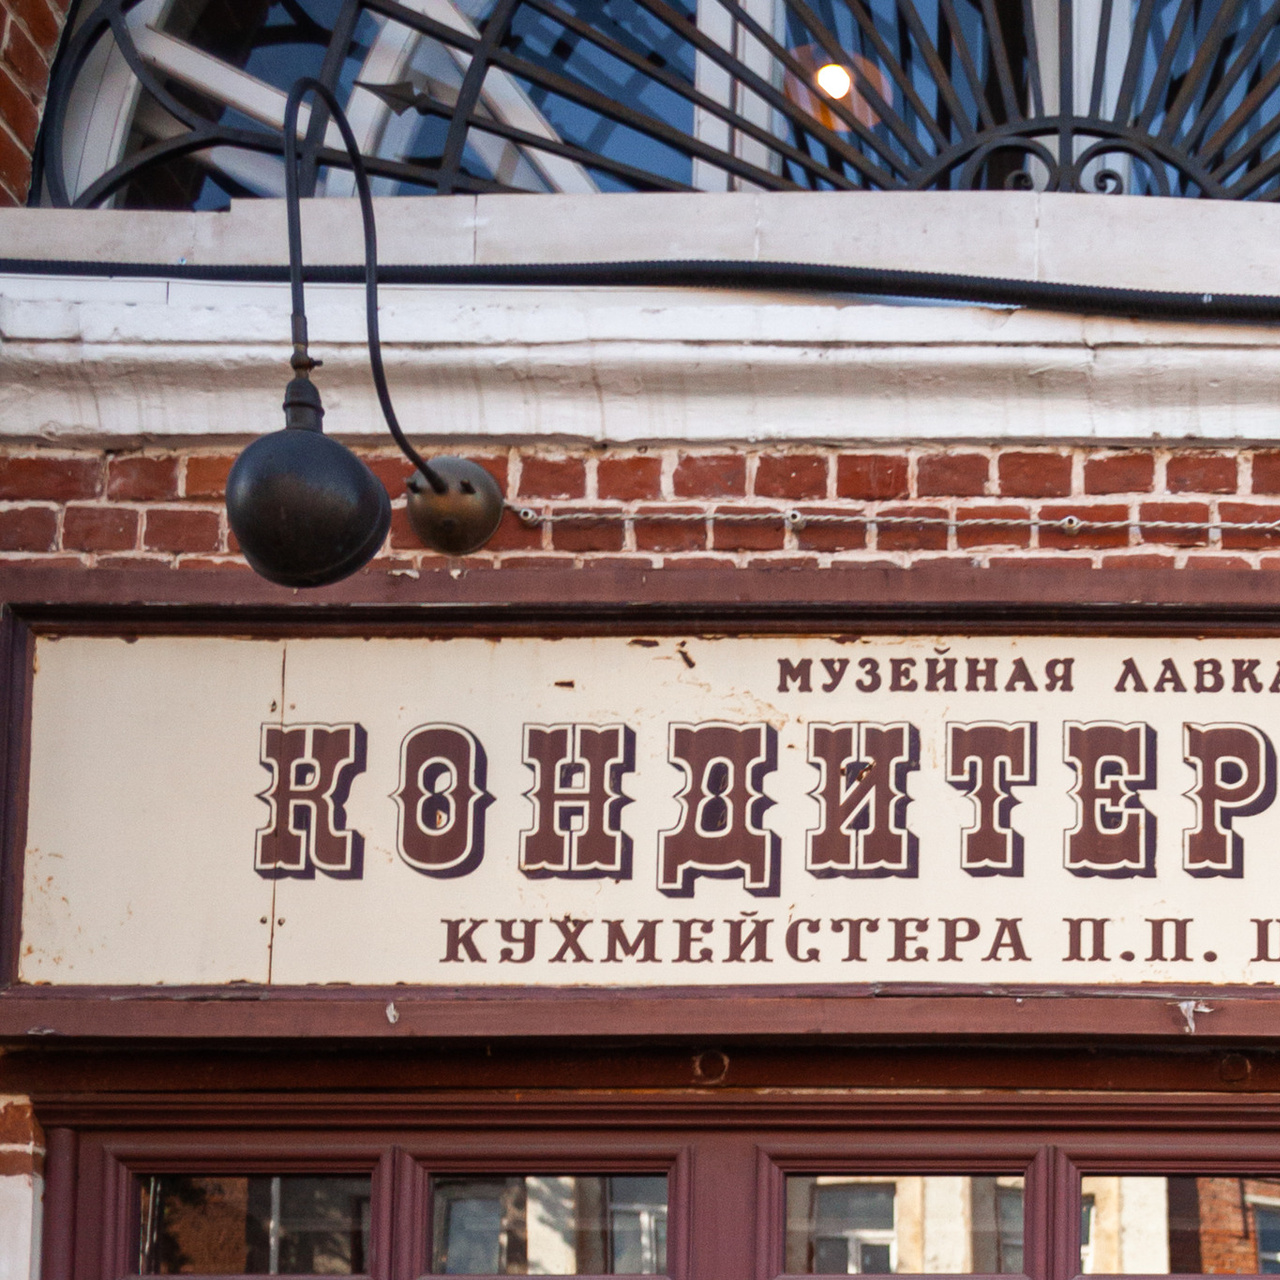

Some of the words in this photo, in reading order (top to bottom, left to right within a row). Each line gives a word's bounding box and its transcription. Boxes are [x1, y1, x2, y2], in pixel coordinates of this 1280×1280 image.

[777, 648, 1075, 693] МУЗЕЙНАЯ
[440, 911, 1033, 964] КУХМЕЙСТЕРА
[1063, 917, 1218, 963] П.П.
